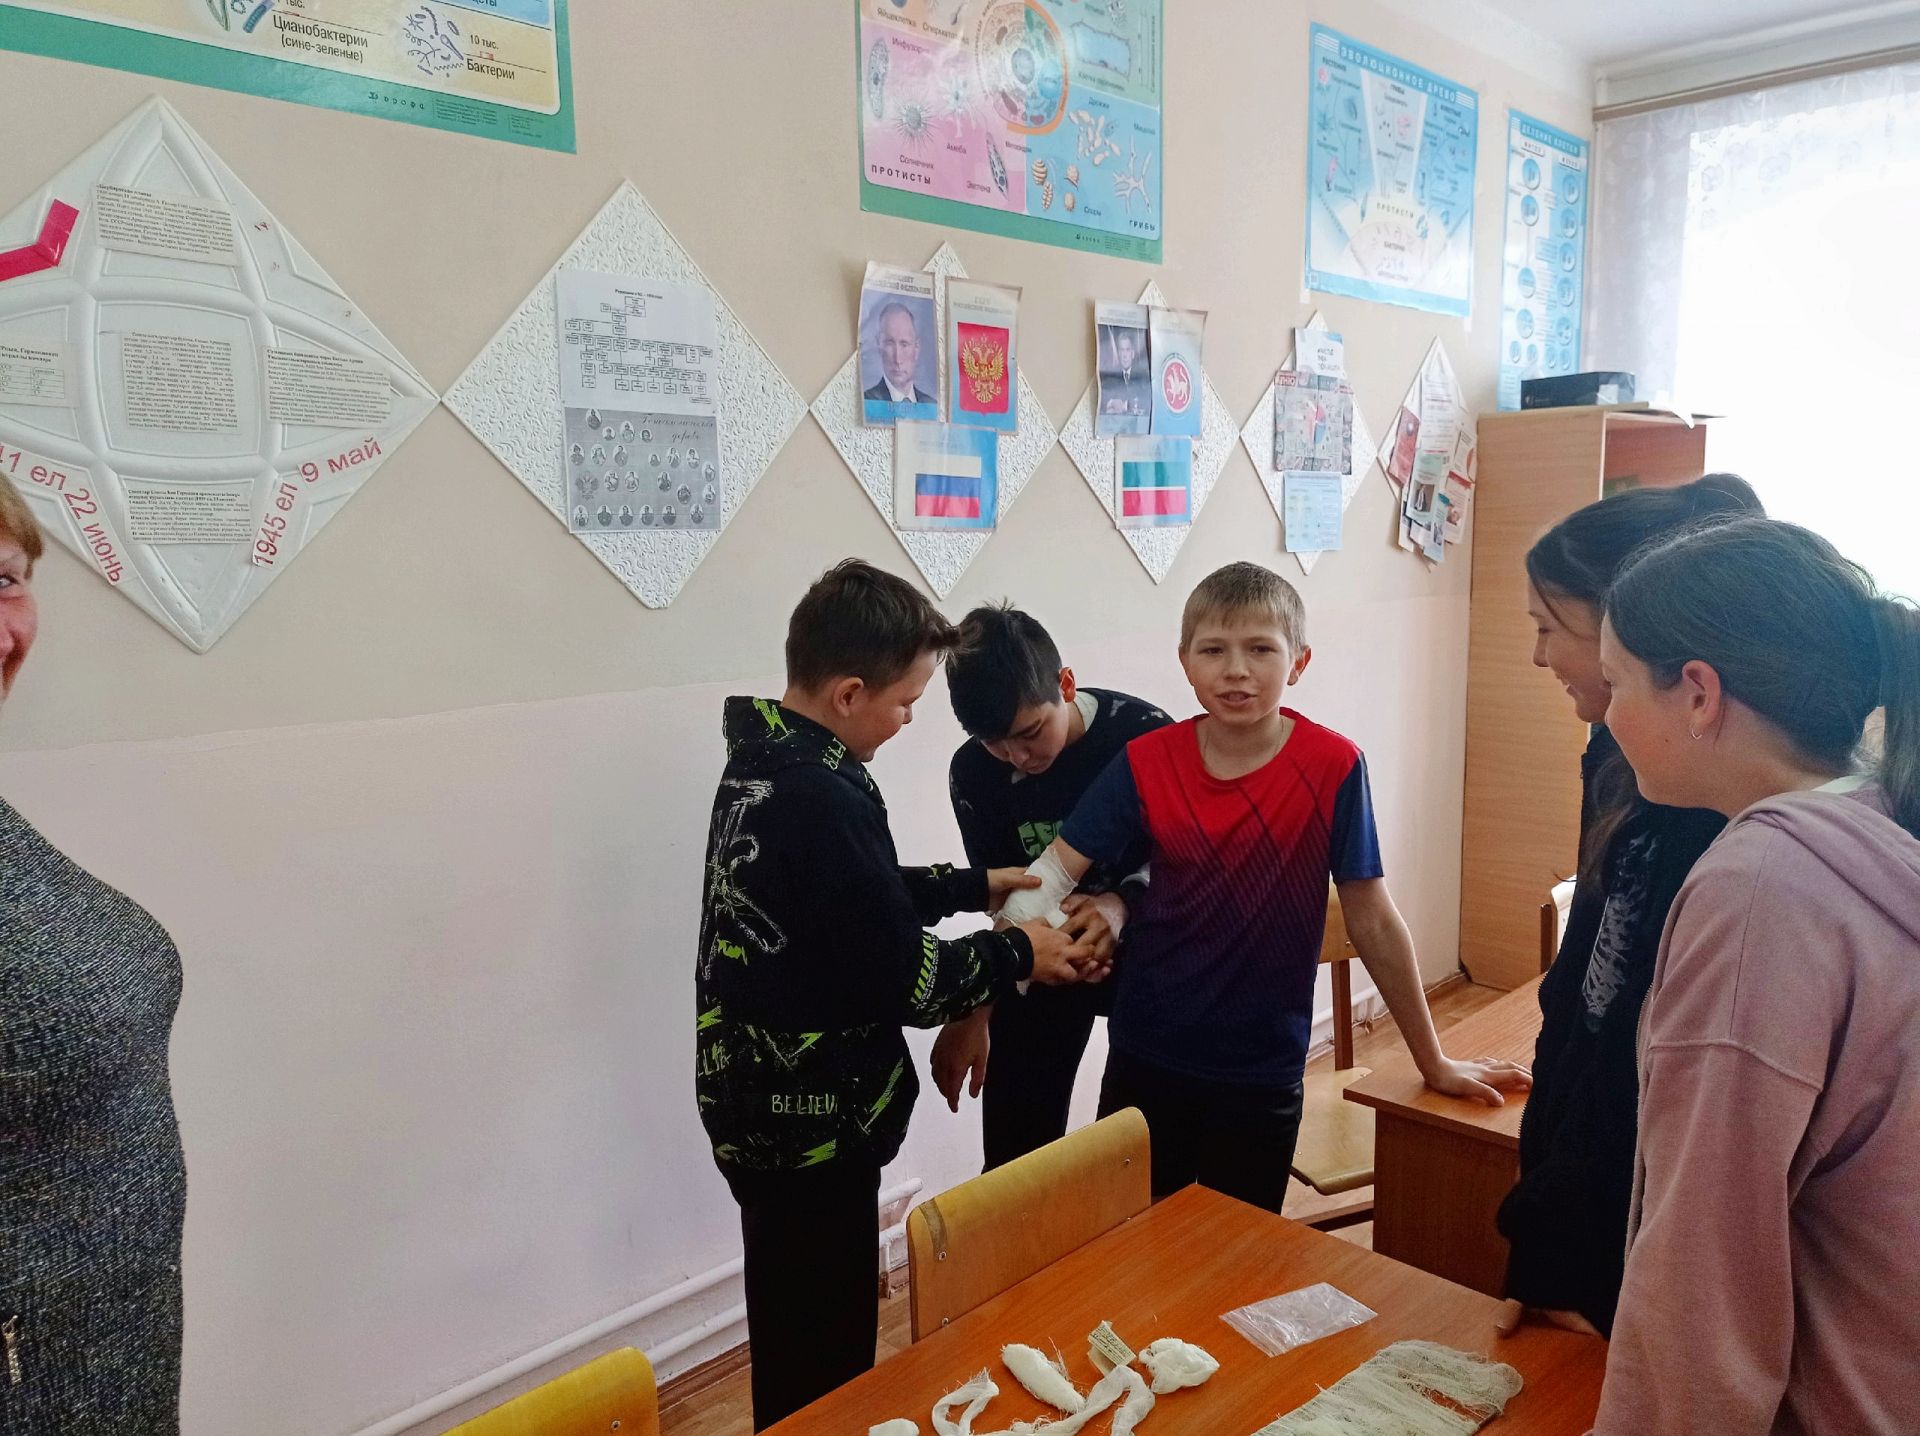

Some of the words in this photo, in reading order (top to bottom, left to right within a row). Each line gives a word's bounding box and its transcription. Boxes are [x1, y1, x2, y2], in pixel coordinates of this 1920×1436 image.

[273, 14, 368, 48] Цианобактерии
[470, 34, 480, 45] 10
[482, 39, 499, 50] тыс.
[281, 34, 363, 63] (сине-зеленые)
[466, 58, 515, 81] Бактерии
[1427, 81, 1456, 102] ДРЕВО
[899, 153, 935, 170] Солнечник
[871, 164, 931, 185] ПРОТИСТЫ
[1129, 219, 1156, 231] ГРИБЫ
[254, 513, 286, 565] 1945
[275, 482, 298, 511] ел
[301, 462, 319, 482] 9
[327, 437, 382, 473] май
[30, 465, 67, 491] ел
[64, 488, 98, 520] 22
[83, 522, 124, 583] июнь
[772, 1093, 839, 1115] BELIEV
